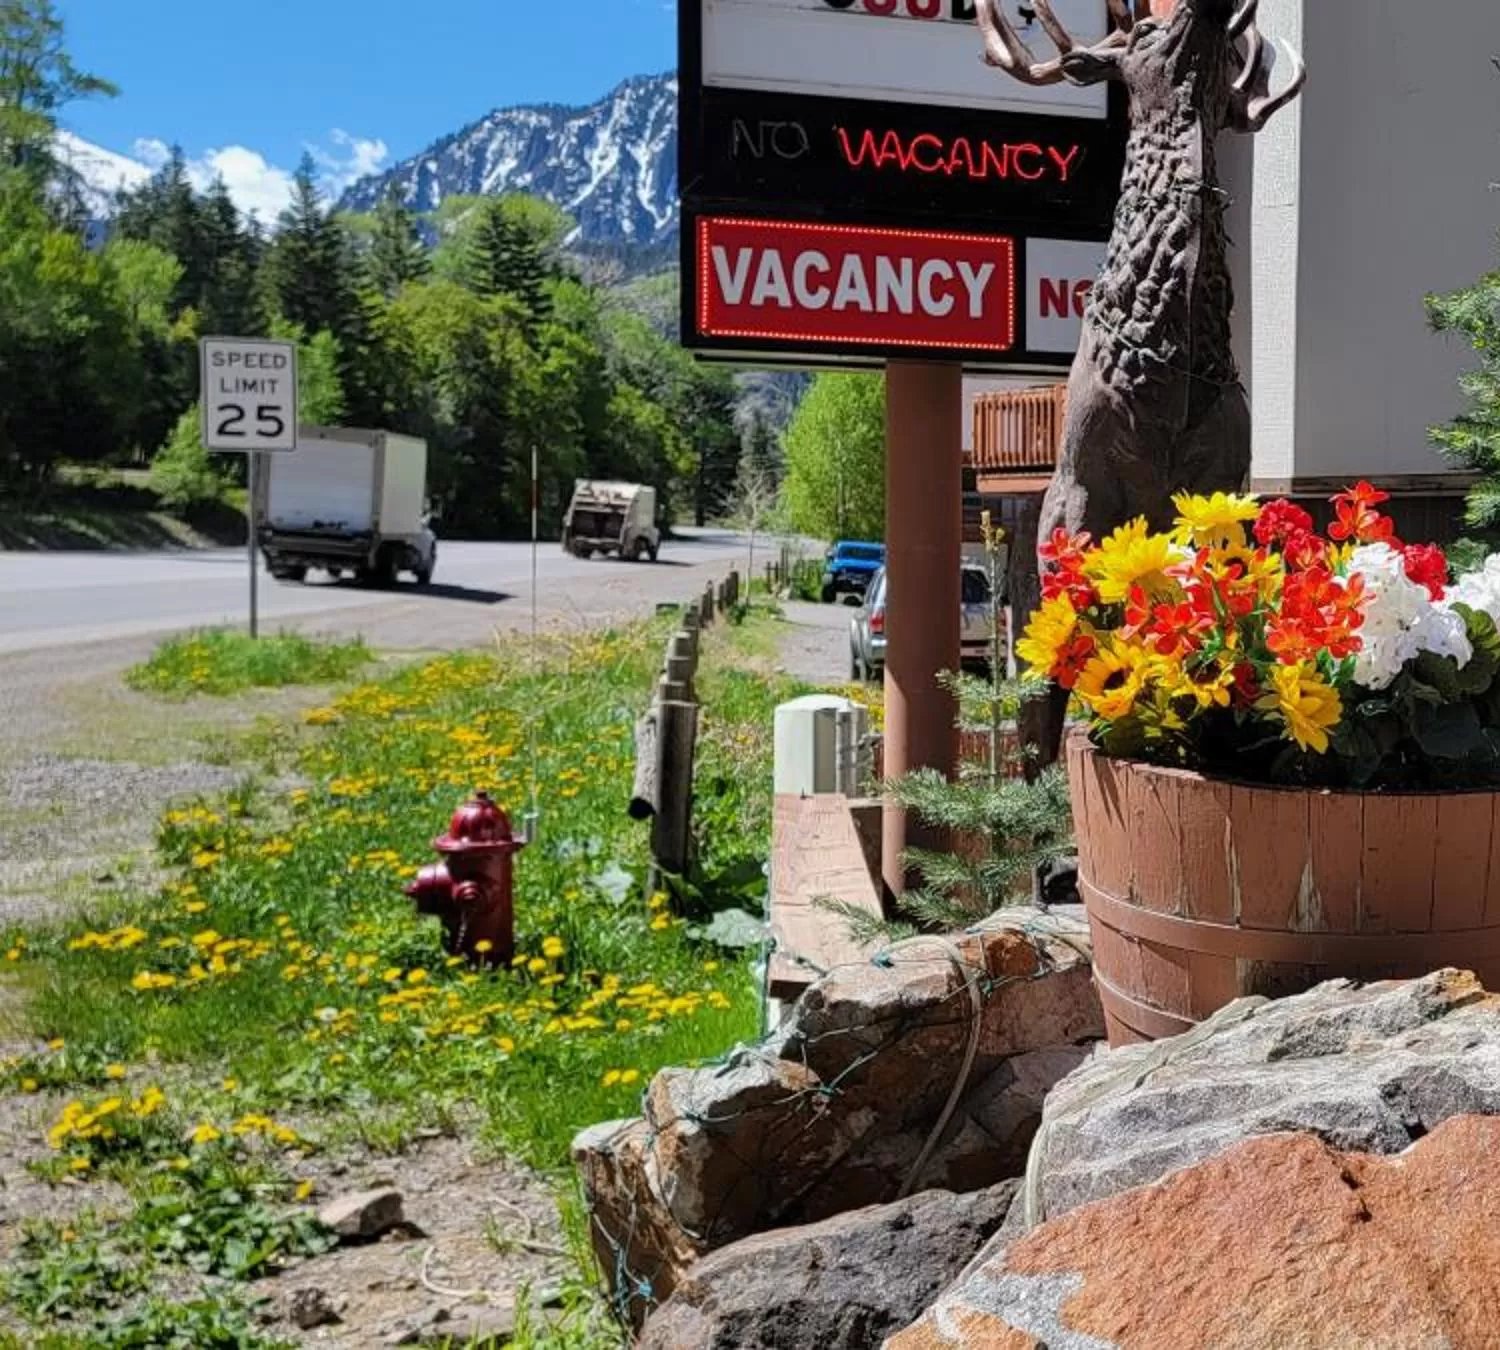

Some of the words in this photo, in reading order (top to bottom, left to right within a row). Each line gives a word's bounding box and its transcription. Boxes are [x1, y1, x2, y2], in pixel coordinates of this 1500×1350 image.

[838, 126, 1080, 182] VACANCY
[711, 246, 995, 318] VACANCY
[211, 350, 287, 369] SPEED
[220, 376, 279, 395] LIMIT
[216, 403, 285, 437] 25
